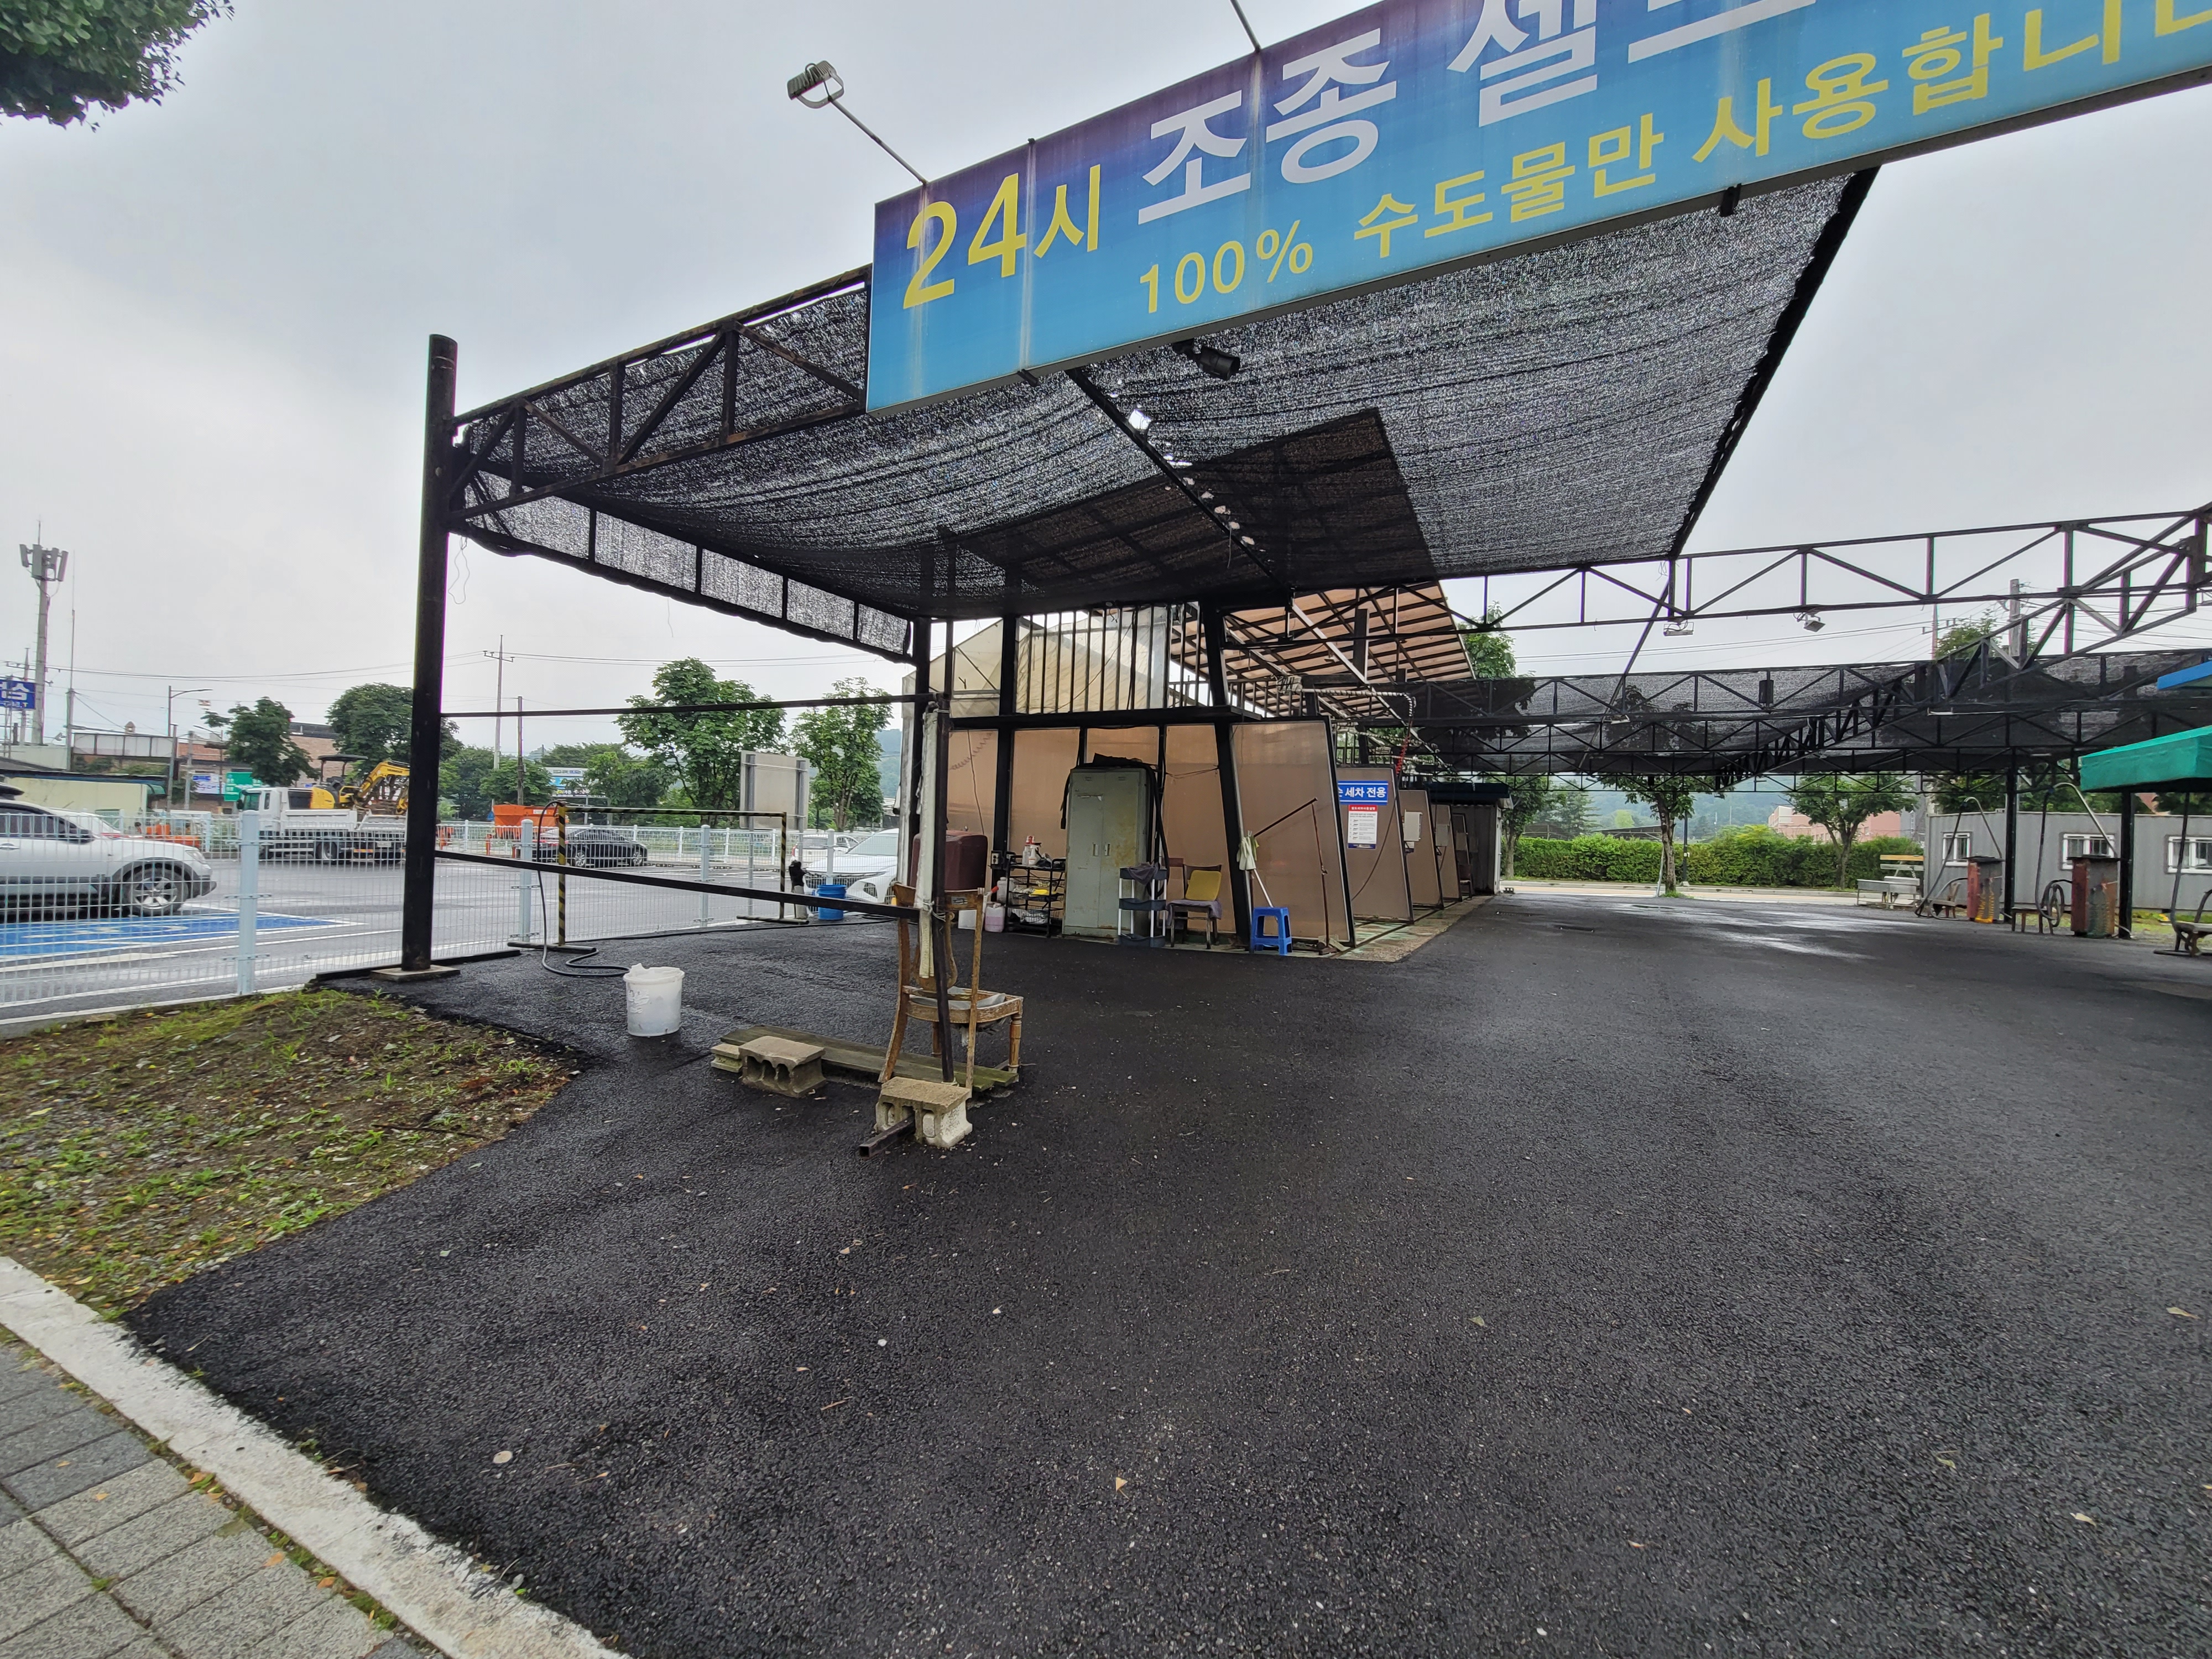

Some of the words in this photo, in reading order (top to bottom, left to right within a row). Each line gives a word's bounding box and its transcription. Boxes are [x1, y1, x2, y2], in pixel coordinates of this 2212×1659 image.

[904, 164, 1100, 309] 24시
[1138, 28, 1397, 225] 조종
[1139, 220, 1313, 314] 100%
[1354, 113, 1665, 258] 수도물만
[1344, 786, 1365, 797] 세차
[1366, 786, 1386, 798] 전용
